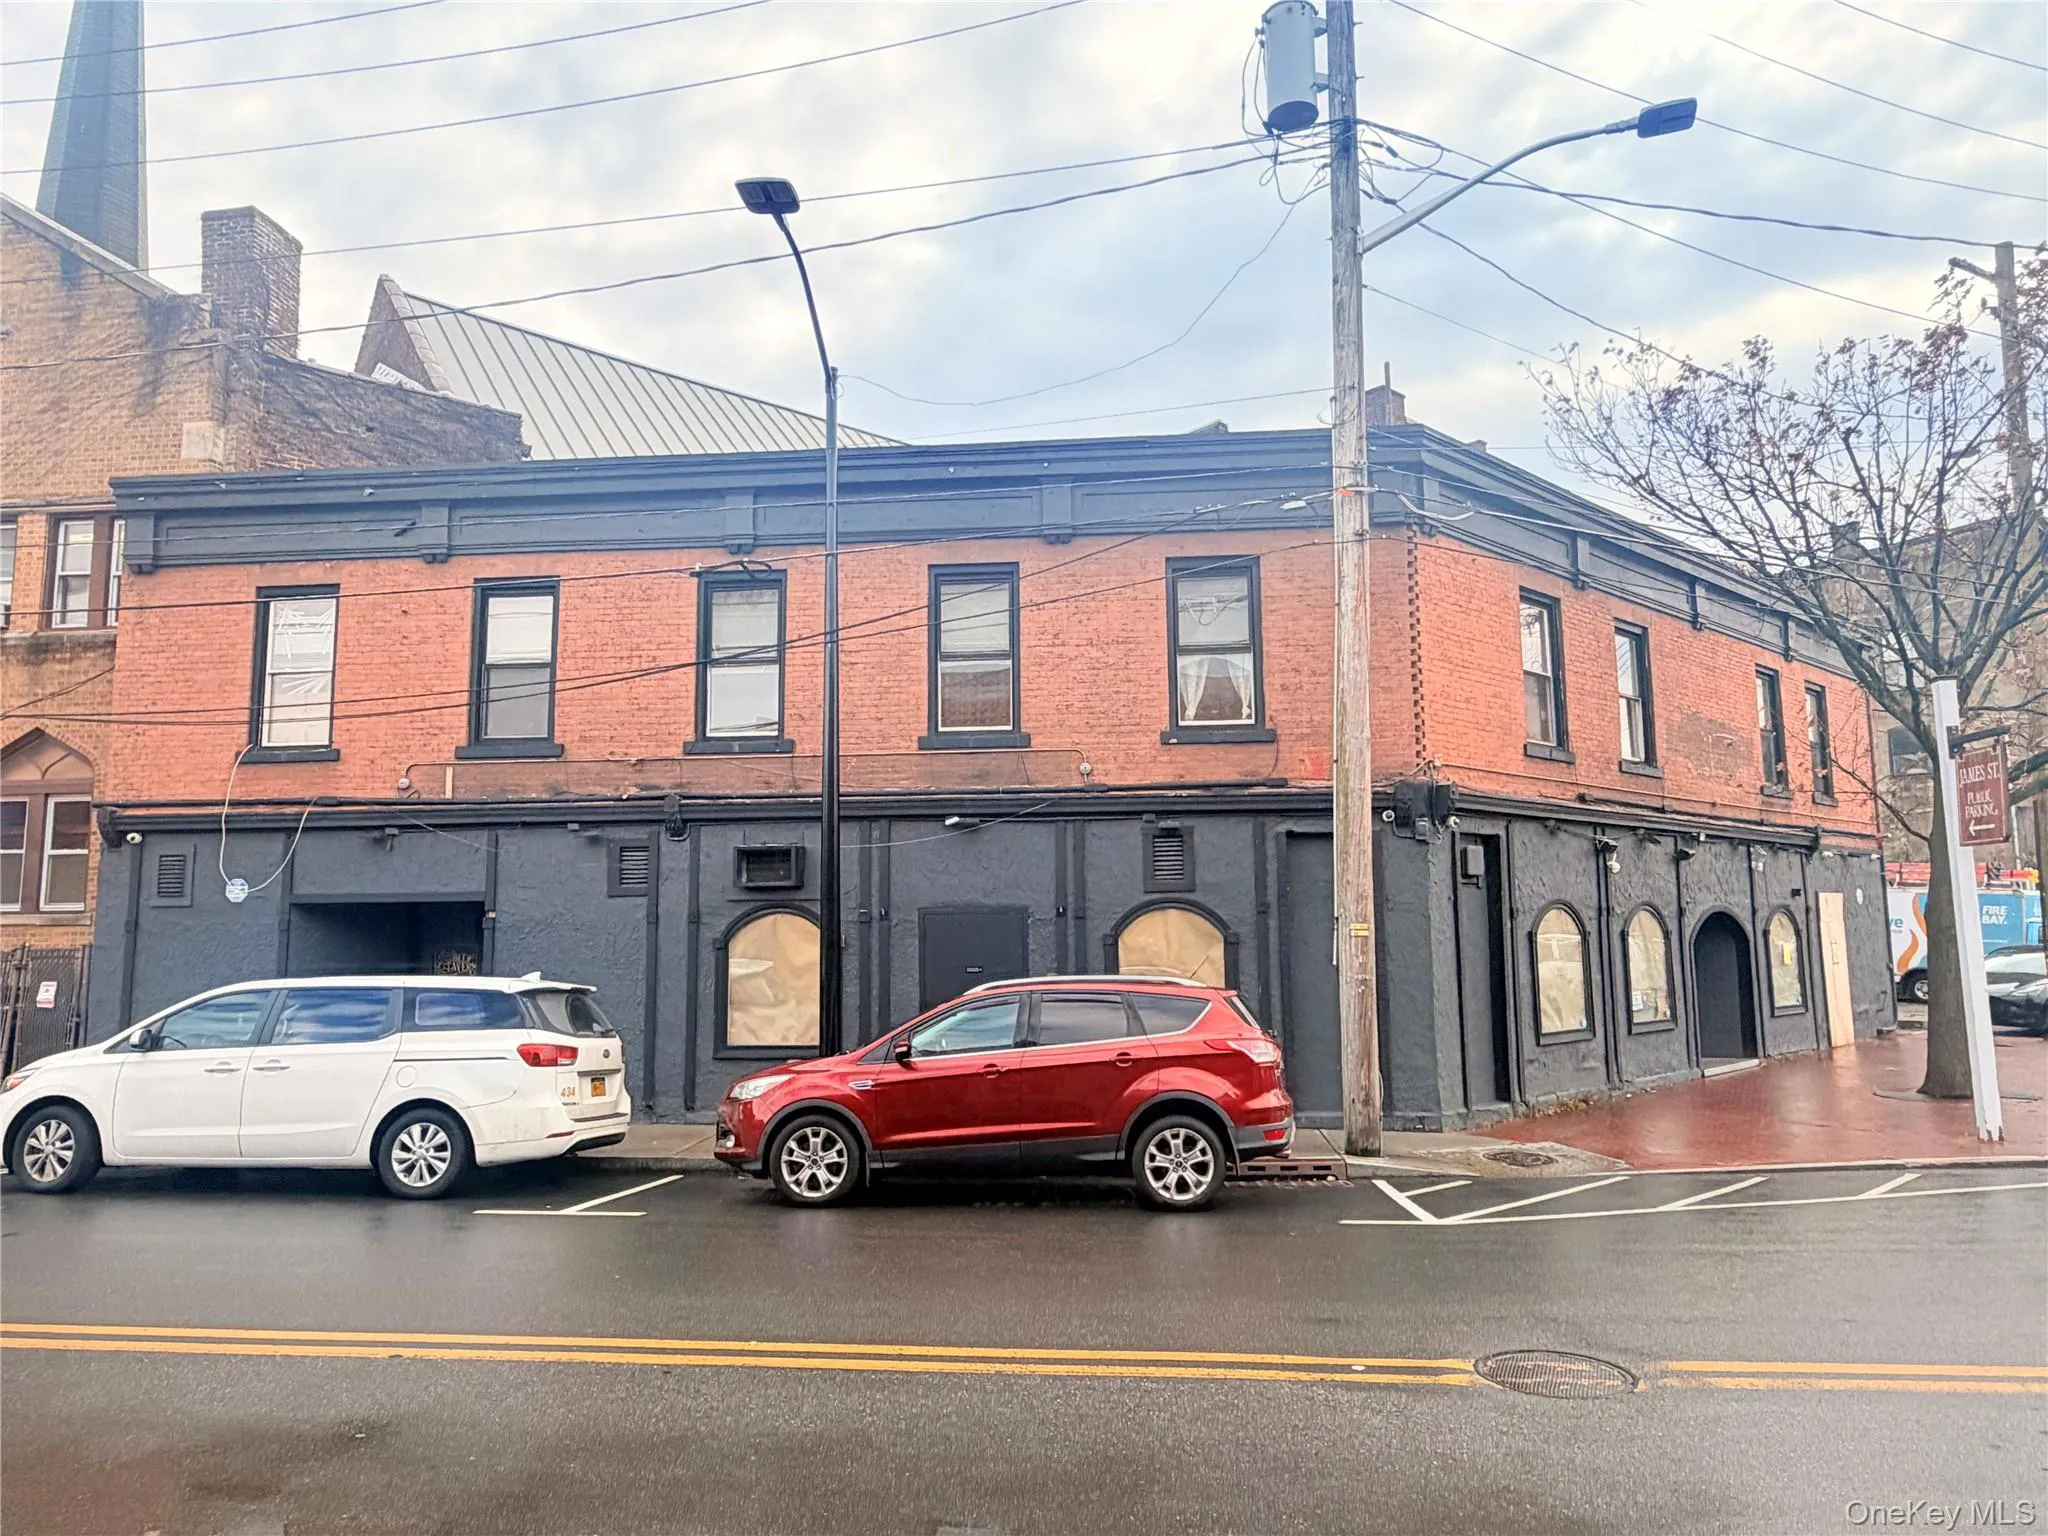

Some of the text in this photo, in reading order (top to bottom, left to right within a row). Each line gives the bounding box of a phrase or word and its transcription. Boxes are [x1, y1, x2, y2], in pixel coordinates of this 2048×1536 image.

[1960, 765, 1986, 785] JAMES
[1967, 789, 1993, 805] PUBLIC
[1965, 803, 1998, 820] PARKING
[1982, 905, 2008, 915] FIRE
[1982, 914, 2008, 925] BAY.
[560, 1086, 576, 1098] 434
